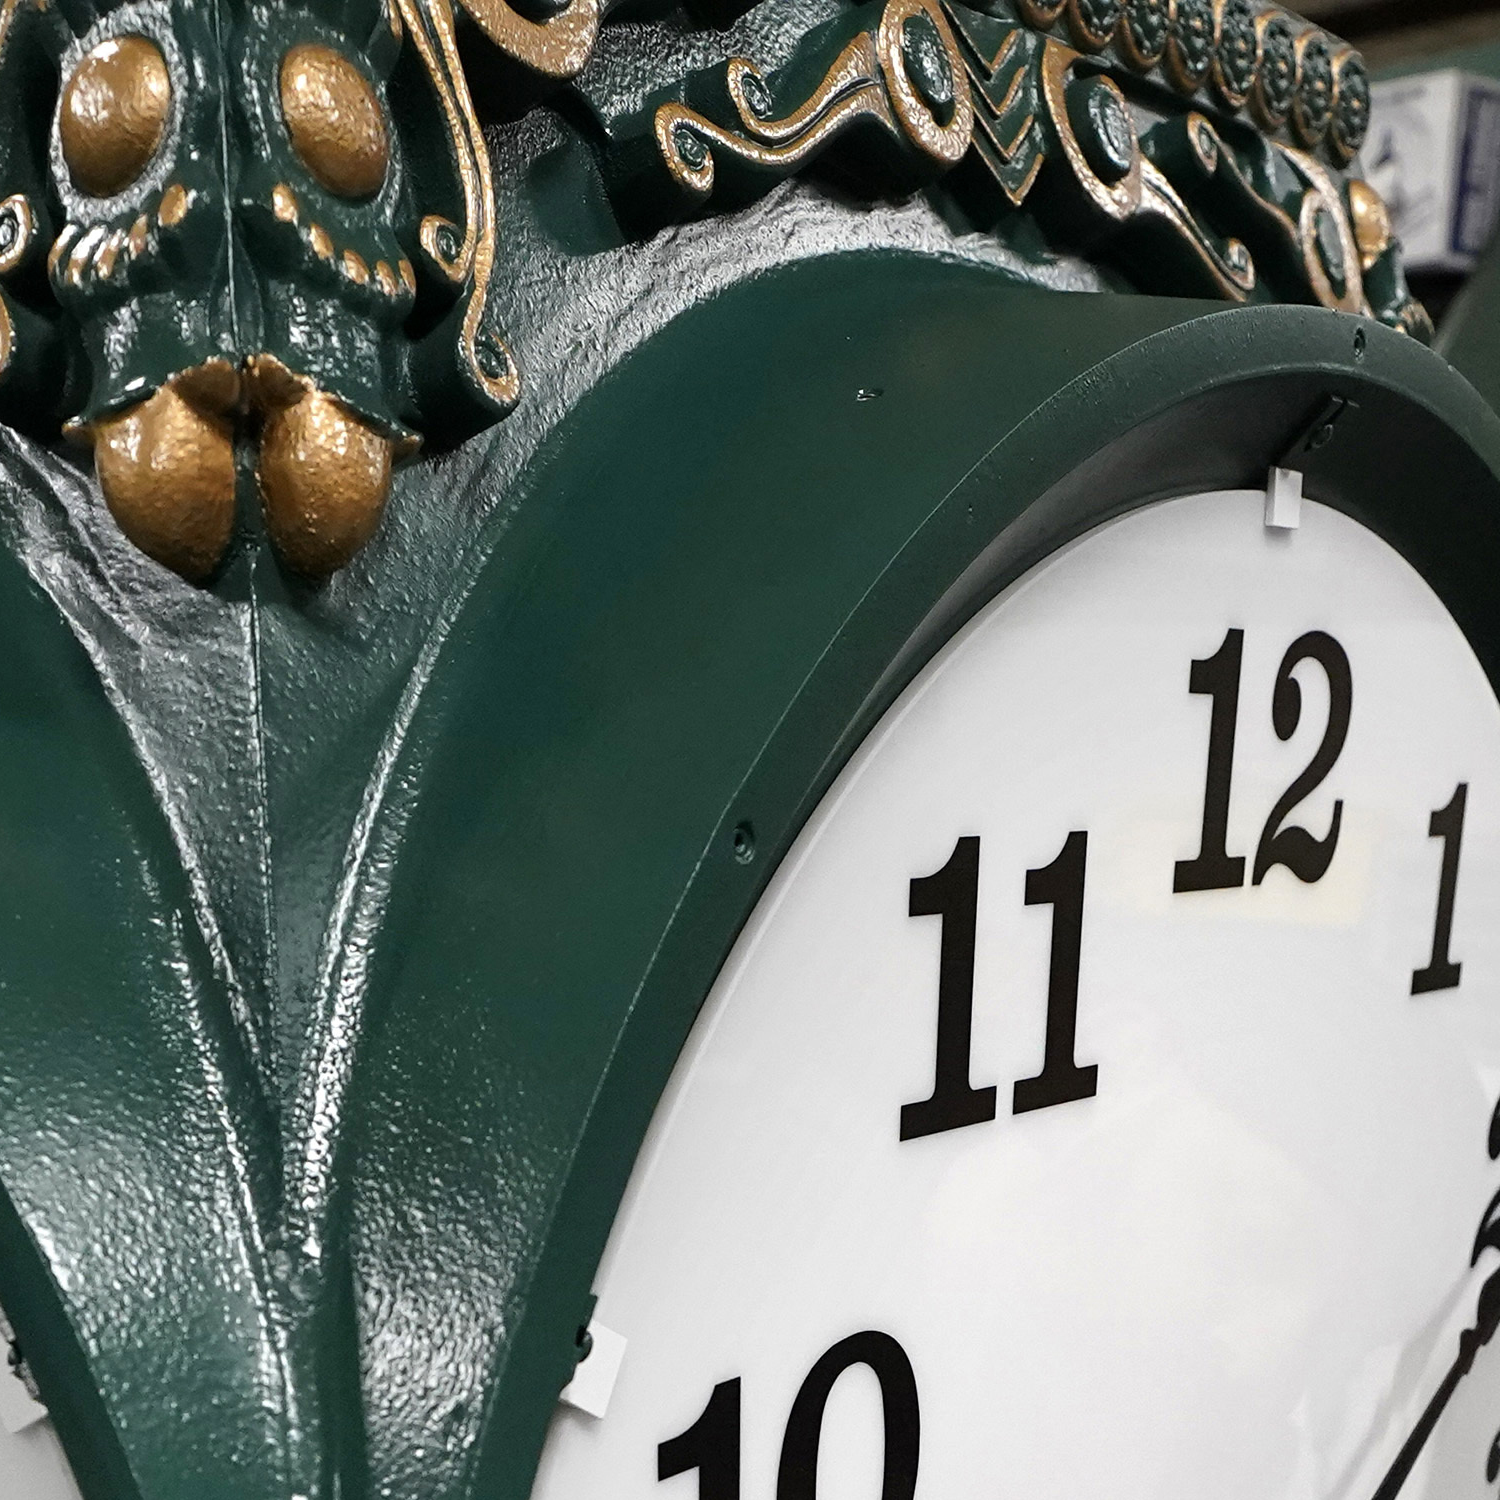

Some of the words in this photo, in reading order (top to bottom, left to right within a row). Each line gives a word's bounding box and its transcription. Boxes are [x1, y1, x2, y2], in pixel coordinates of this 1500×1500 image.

[1173, 628, 1352, 893] 12
[1410, 783, 1468, 996] 1
[900, 831, 1098, 1142] 11
